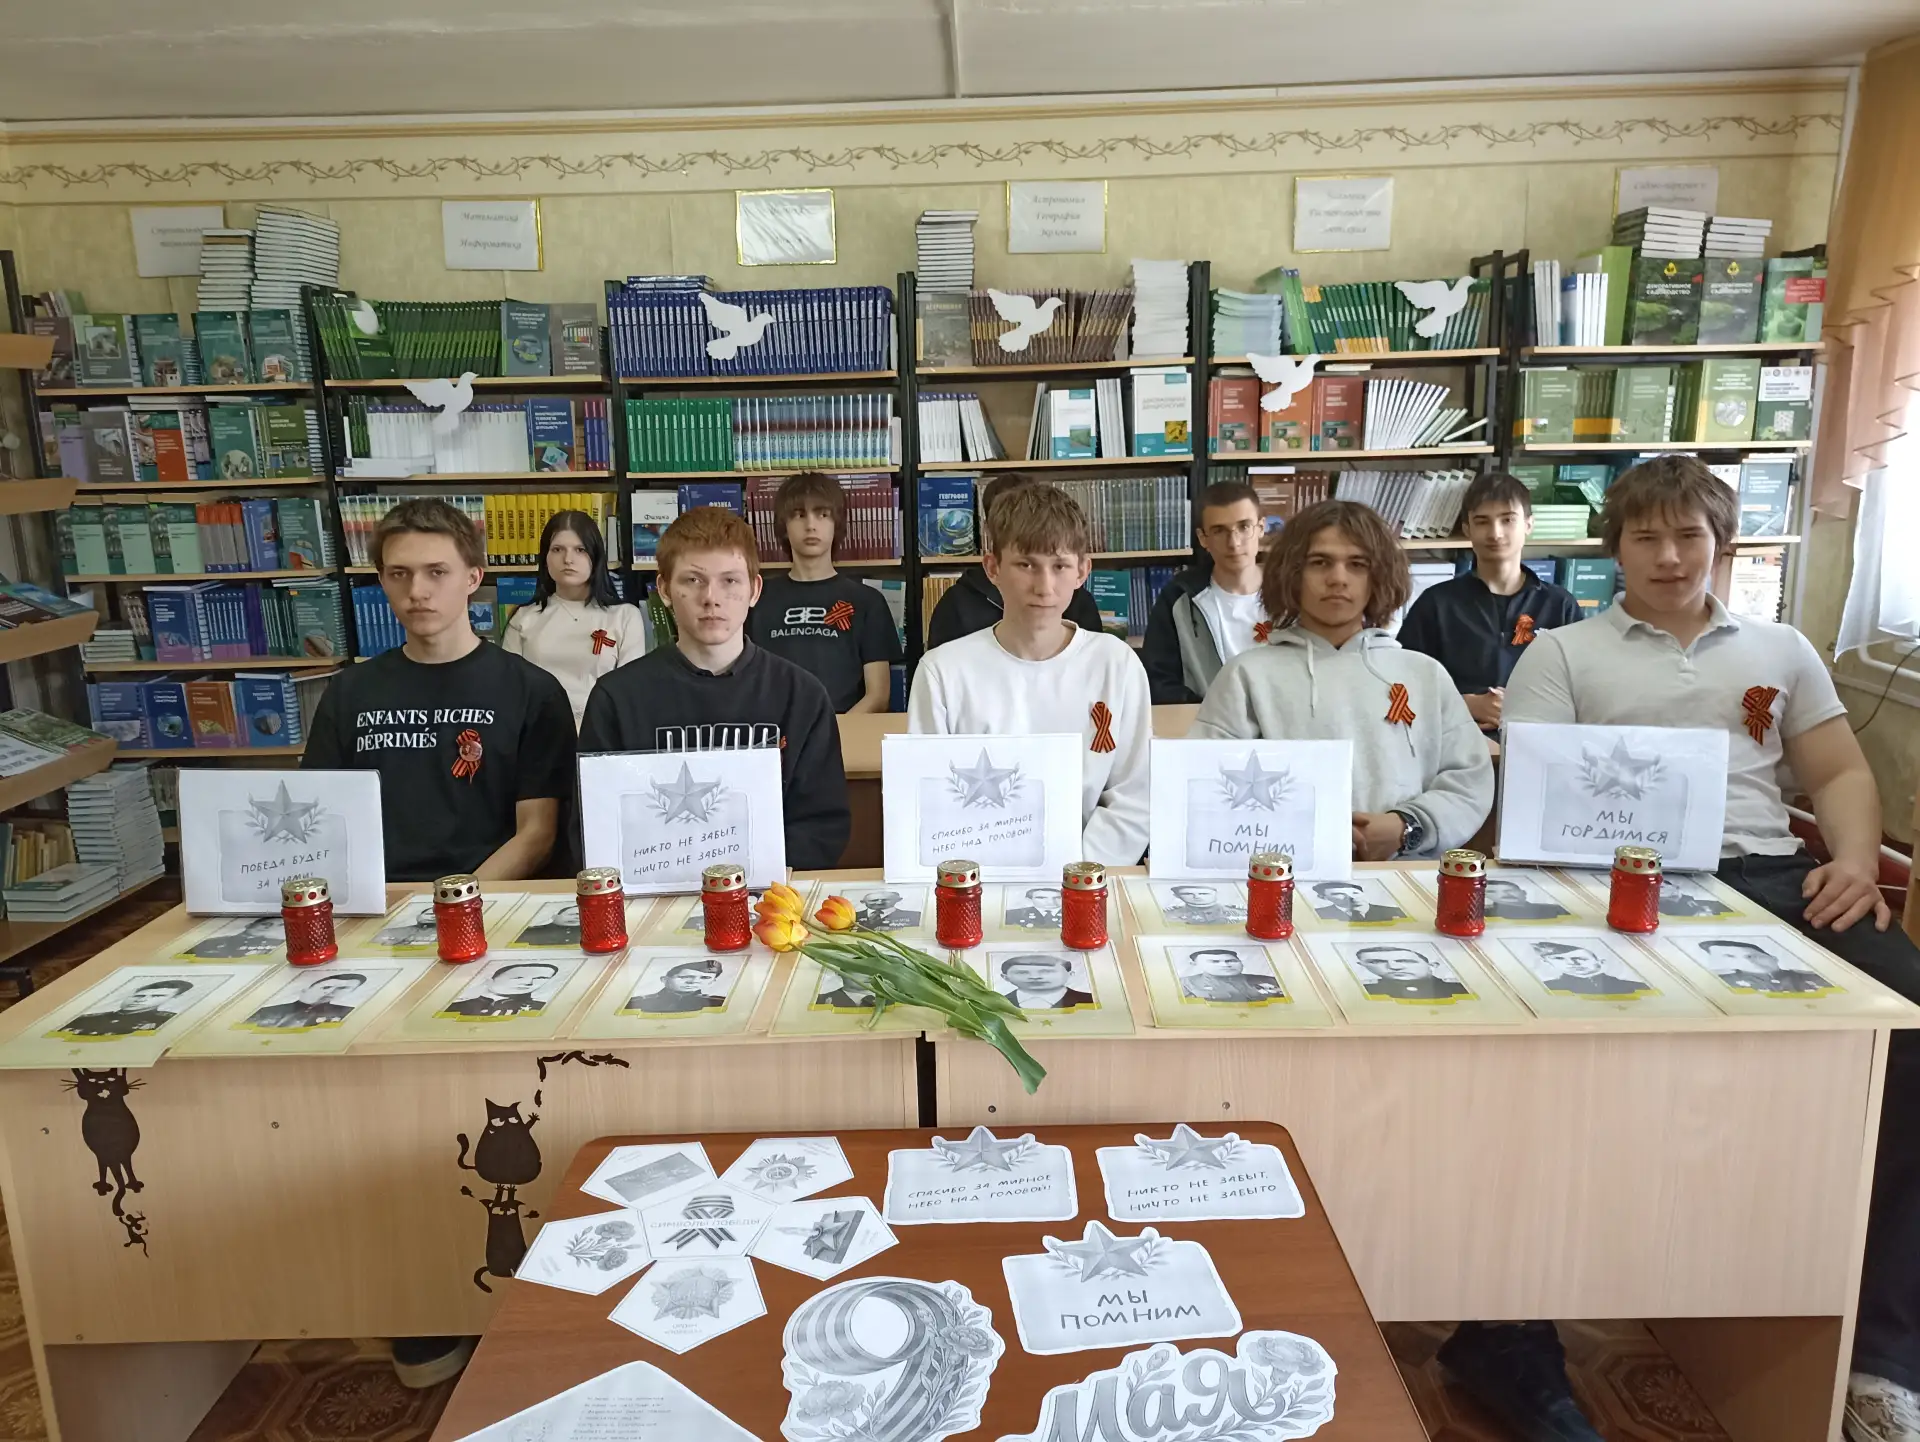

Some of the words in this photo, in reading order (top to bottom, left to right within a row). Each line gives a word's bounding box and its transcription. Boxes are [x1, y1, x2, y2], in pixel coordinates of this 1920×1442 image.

[770, 627, 838, 638] BALENCIAGA
[356, 710, 428, 728] ENFANTS
[433, 708, 495, 724] RICHES
[356, 727, 437, 753] DÉPRIMÉS
[931, 826, 973, 840] СПАСИБО
[978, 822, 990, 831] ЗА
[994, 813, 1033, 828] МИРНОЕ
[1596, 810, 1633, 824] МЫ
[1234, 823, 1268, 837] МЫ
[1561, 824, 1668, 844] ГОРДИМСЯ
[633, 842, 671, 859] НИКТО
[678, 836, 693, 847] НЕ
[932, 843, 956, 854] НЕБО
[961, 838, 982, 848] НАД
[1209, 838, 1295, 855] ПОМНИМ
[241, 859, 285, 874] ПОБЕДА
[292, 849, 330, 865] БУДЕТ
[633, 860, 670, 876] НИЧТО
[676, 855, 691, 865] НЕ
[698, 843, 740, 861] ЗАБЫТО
[256, 877, 270, 889] ЗА
[908, 1186, 966, 1199] СПАСИБО
[974, 1182, 990, 1190] ЗА
[997, 1174, 1051, 1186] МИРНОЕ
[908, 1199, 942, 1209] НЕБО
[950, 1195, 979, 1203] НАД
[990, 1184, 1051, 1199] ГОЛОВОЙ!
[1127, 1184, 1179, 1197] НИКТО
[1189, 1179, 1209, 1188] НЕ
[1129, 1198, 1180, 1211] НИЧТО
[1190, 1194, 1209, 1203] НЕ
[1220, 1184, 1277, 1199] ЗАБЫТО
[650, 1220, 709, 1228] СИМВОЛЫ
[711, 1218, 760, 1227] ПОБЕДЫ
[1097, 1290, 1148, 1307] МЫ
[1061, 1304, 1201, 1330] ПОМНИМ
